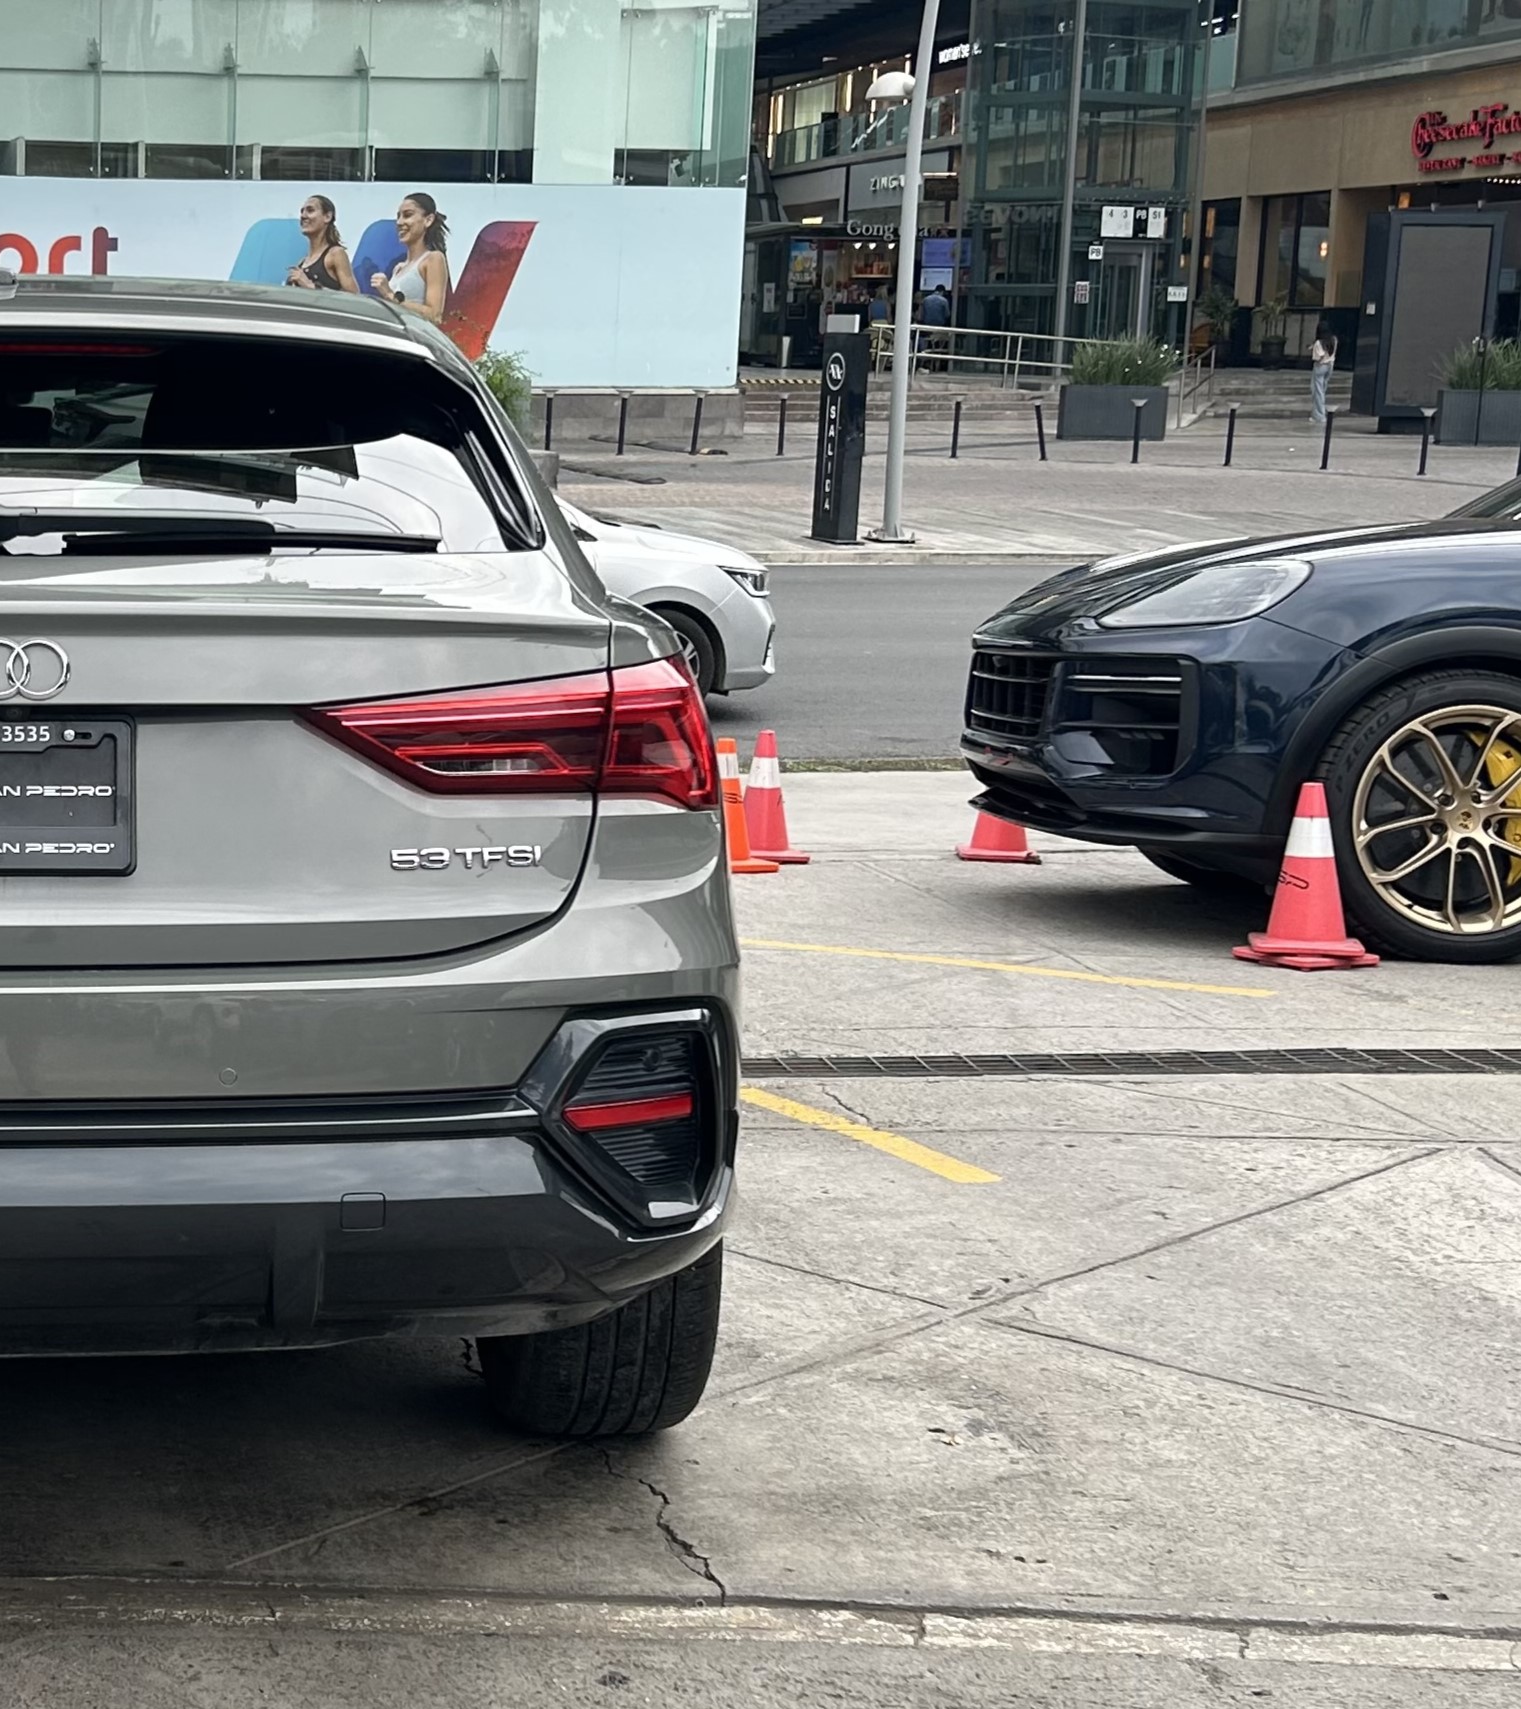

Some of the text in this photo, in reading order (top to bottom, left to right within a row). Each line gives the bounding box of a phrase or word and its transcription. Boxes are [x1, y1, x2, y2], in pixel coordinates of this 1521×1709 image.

[846, 220, 895, 241] Gong
[823, 405, 837, 512] SALIDA
[1, 726, 50, 743] 3535
[391, 845, 542, 870] 53 TFSI
